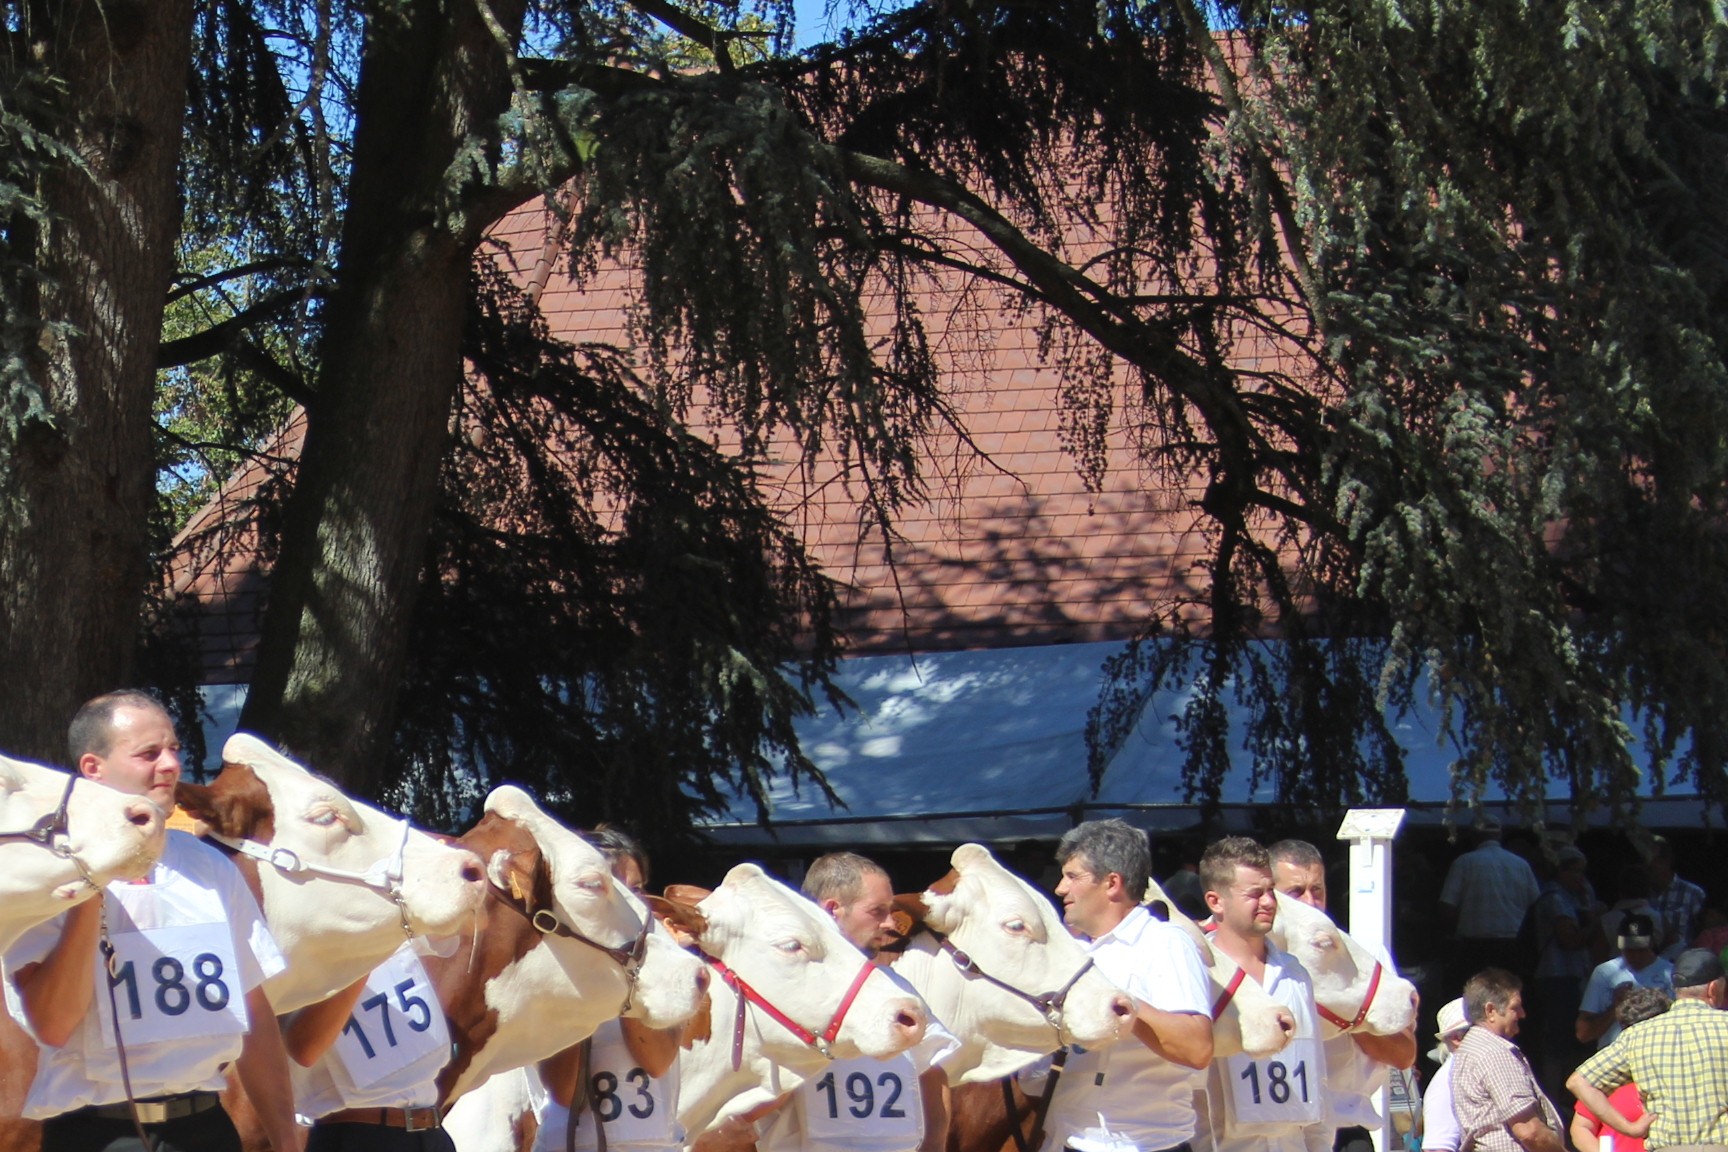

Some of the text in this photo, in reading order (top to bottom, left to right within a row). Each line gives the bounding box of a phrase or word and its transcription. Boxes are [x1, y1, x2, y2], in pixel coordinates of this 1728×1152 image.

[112, 953, 229, 1019] 188
[342, 978, 430, 1059] 175
[816, 1072, 905, 1118] 192
[1241, 1061, 1307, 1104] 181
